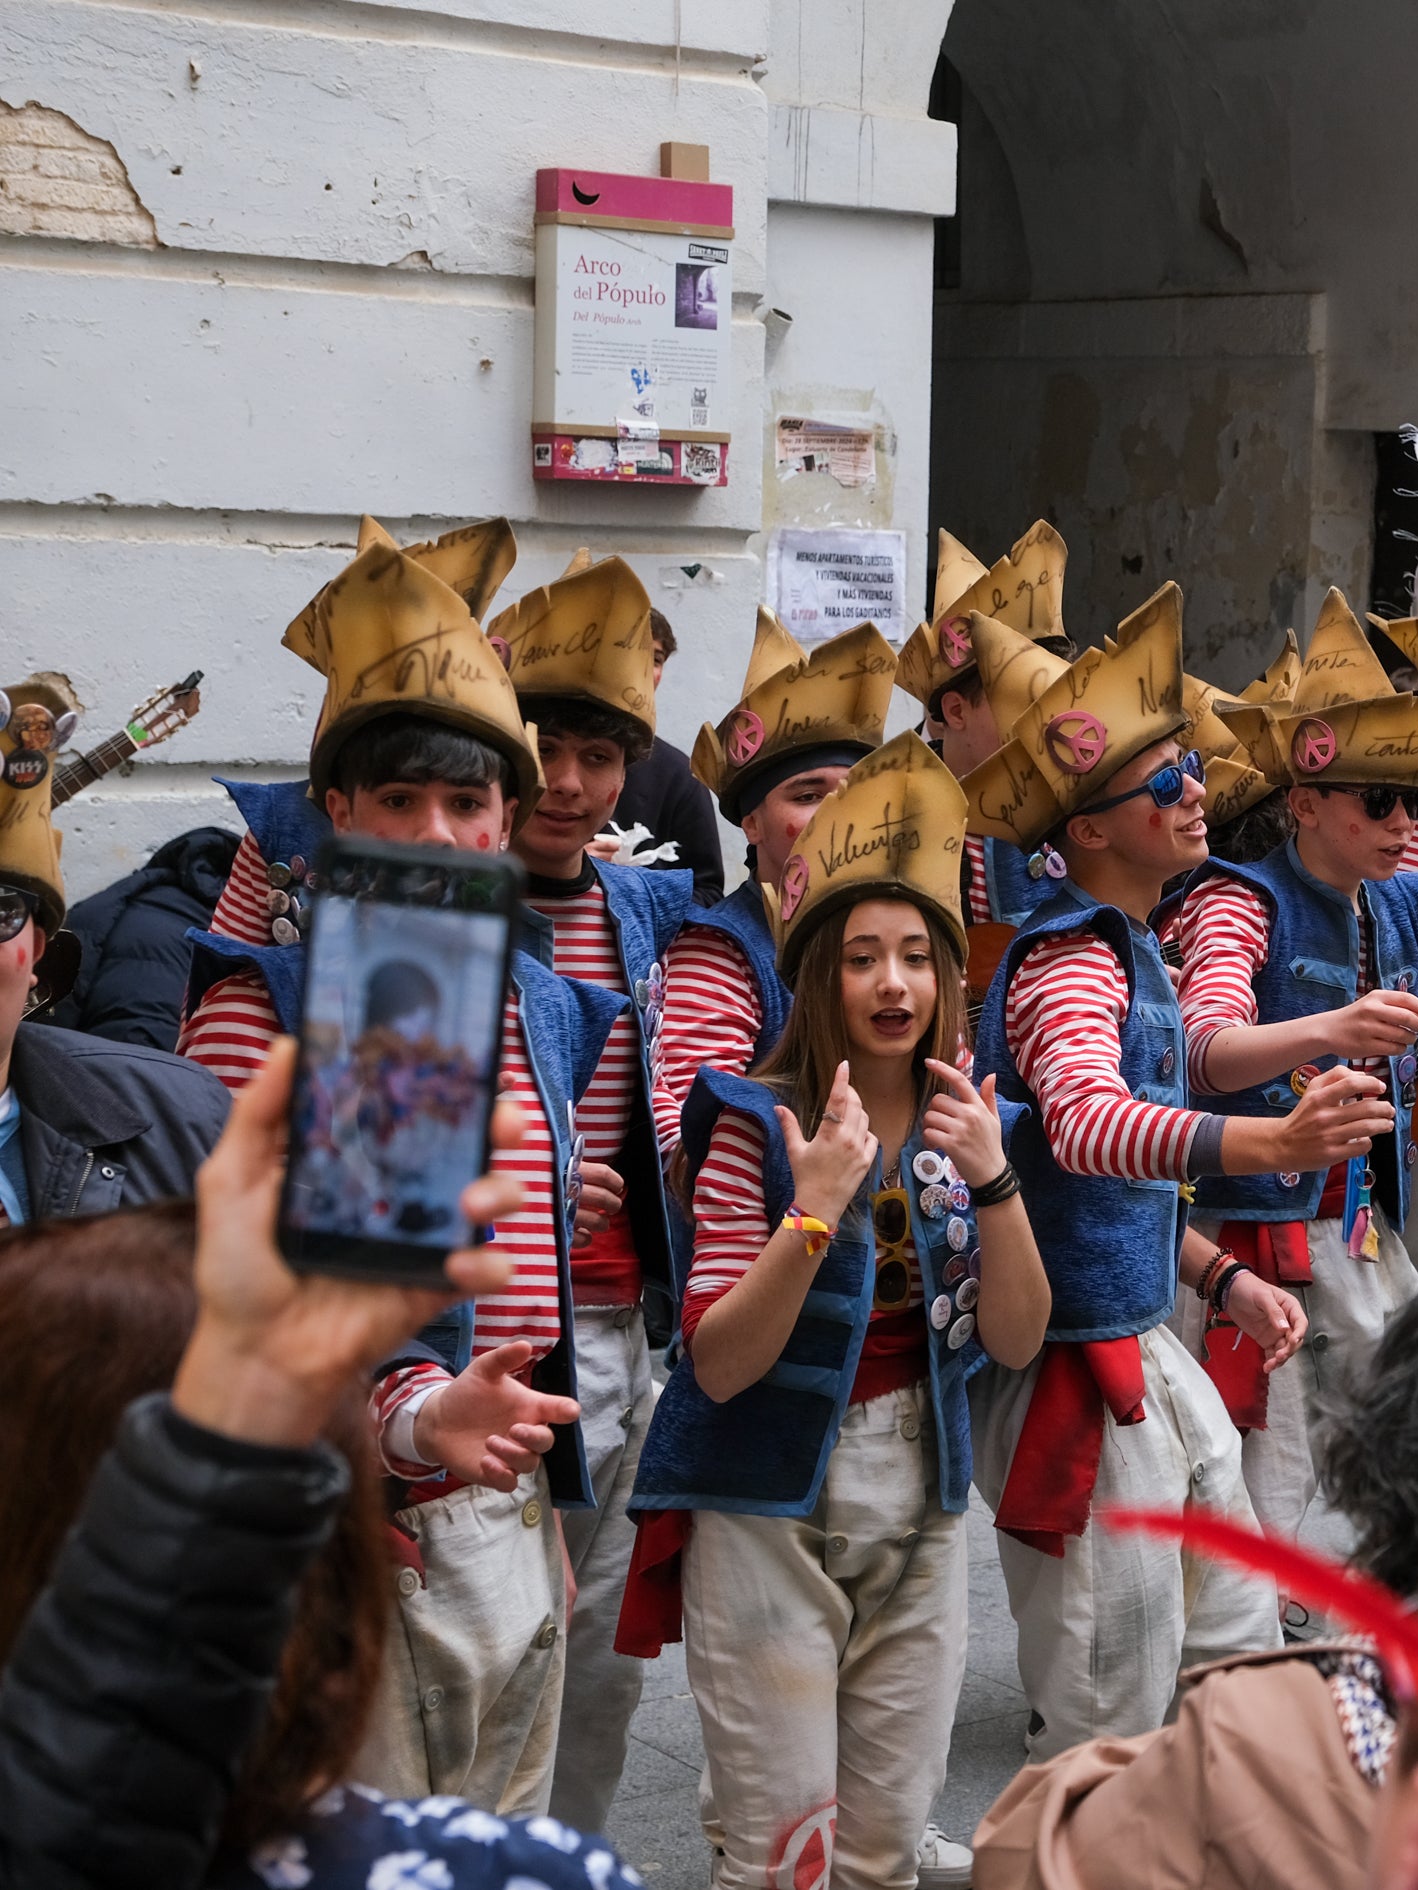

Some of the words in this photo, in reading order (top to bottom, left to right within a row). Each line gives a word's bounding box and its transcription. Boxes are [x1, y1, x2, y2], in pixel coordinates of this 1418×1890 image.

[574, 254, 621, 276] Arco
[573, 286, 592, 300] del
[596, 281, 666, 308] Pópulo
[572, 311, 589, 323] Del
[593, 312, 625, 326] Pópulo
[818, 552, 863, 565] APARTAMENTOS
[824, 606, 840, 618] PARA
[842, 607, 854, 618] LOS
[9, 761, 42, 776] KISS
